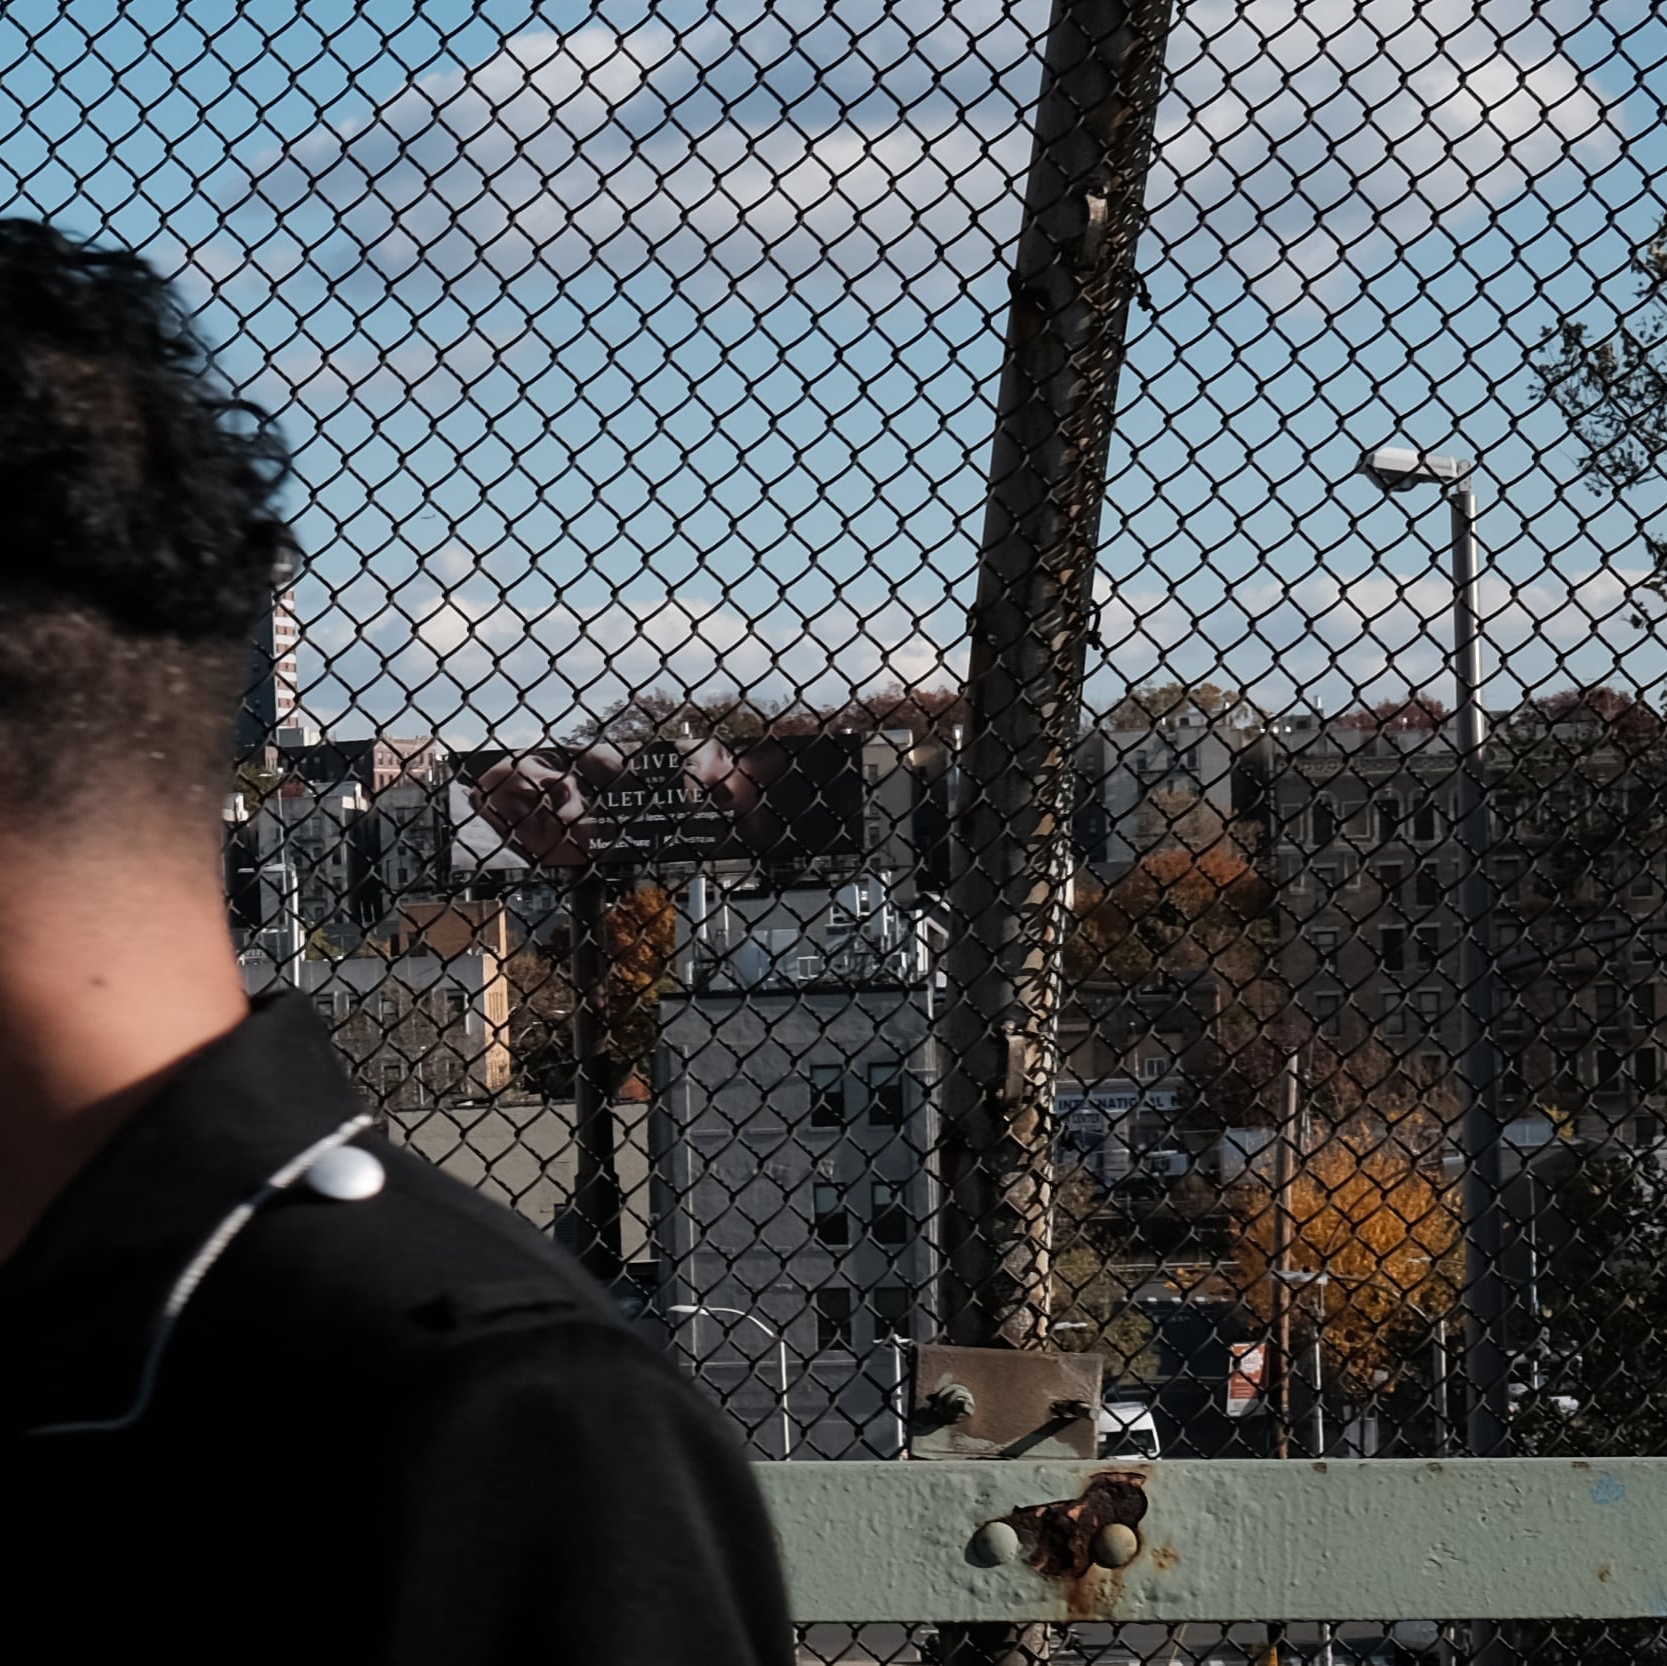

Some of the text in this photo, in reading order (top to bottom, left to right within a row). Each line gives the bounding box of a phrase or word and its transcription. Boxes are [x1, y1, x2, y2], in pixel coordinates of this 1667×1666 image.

[630, 753, 680, 770] LIVE
[608, 788, 704, 807] LET LIVE
[1058, 1097, 1164, 1111] INTENATIOAL
